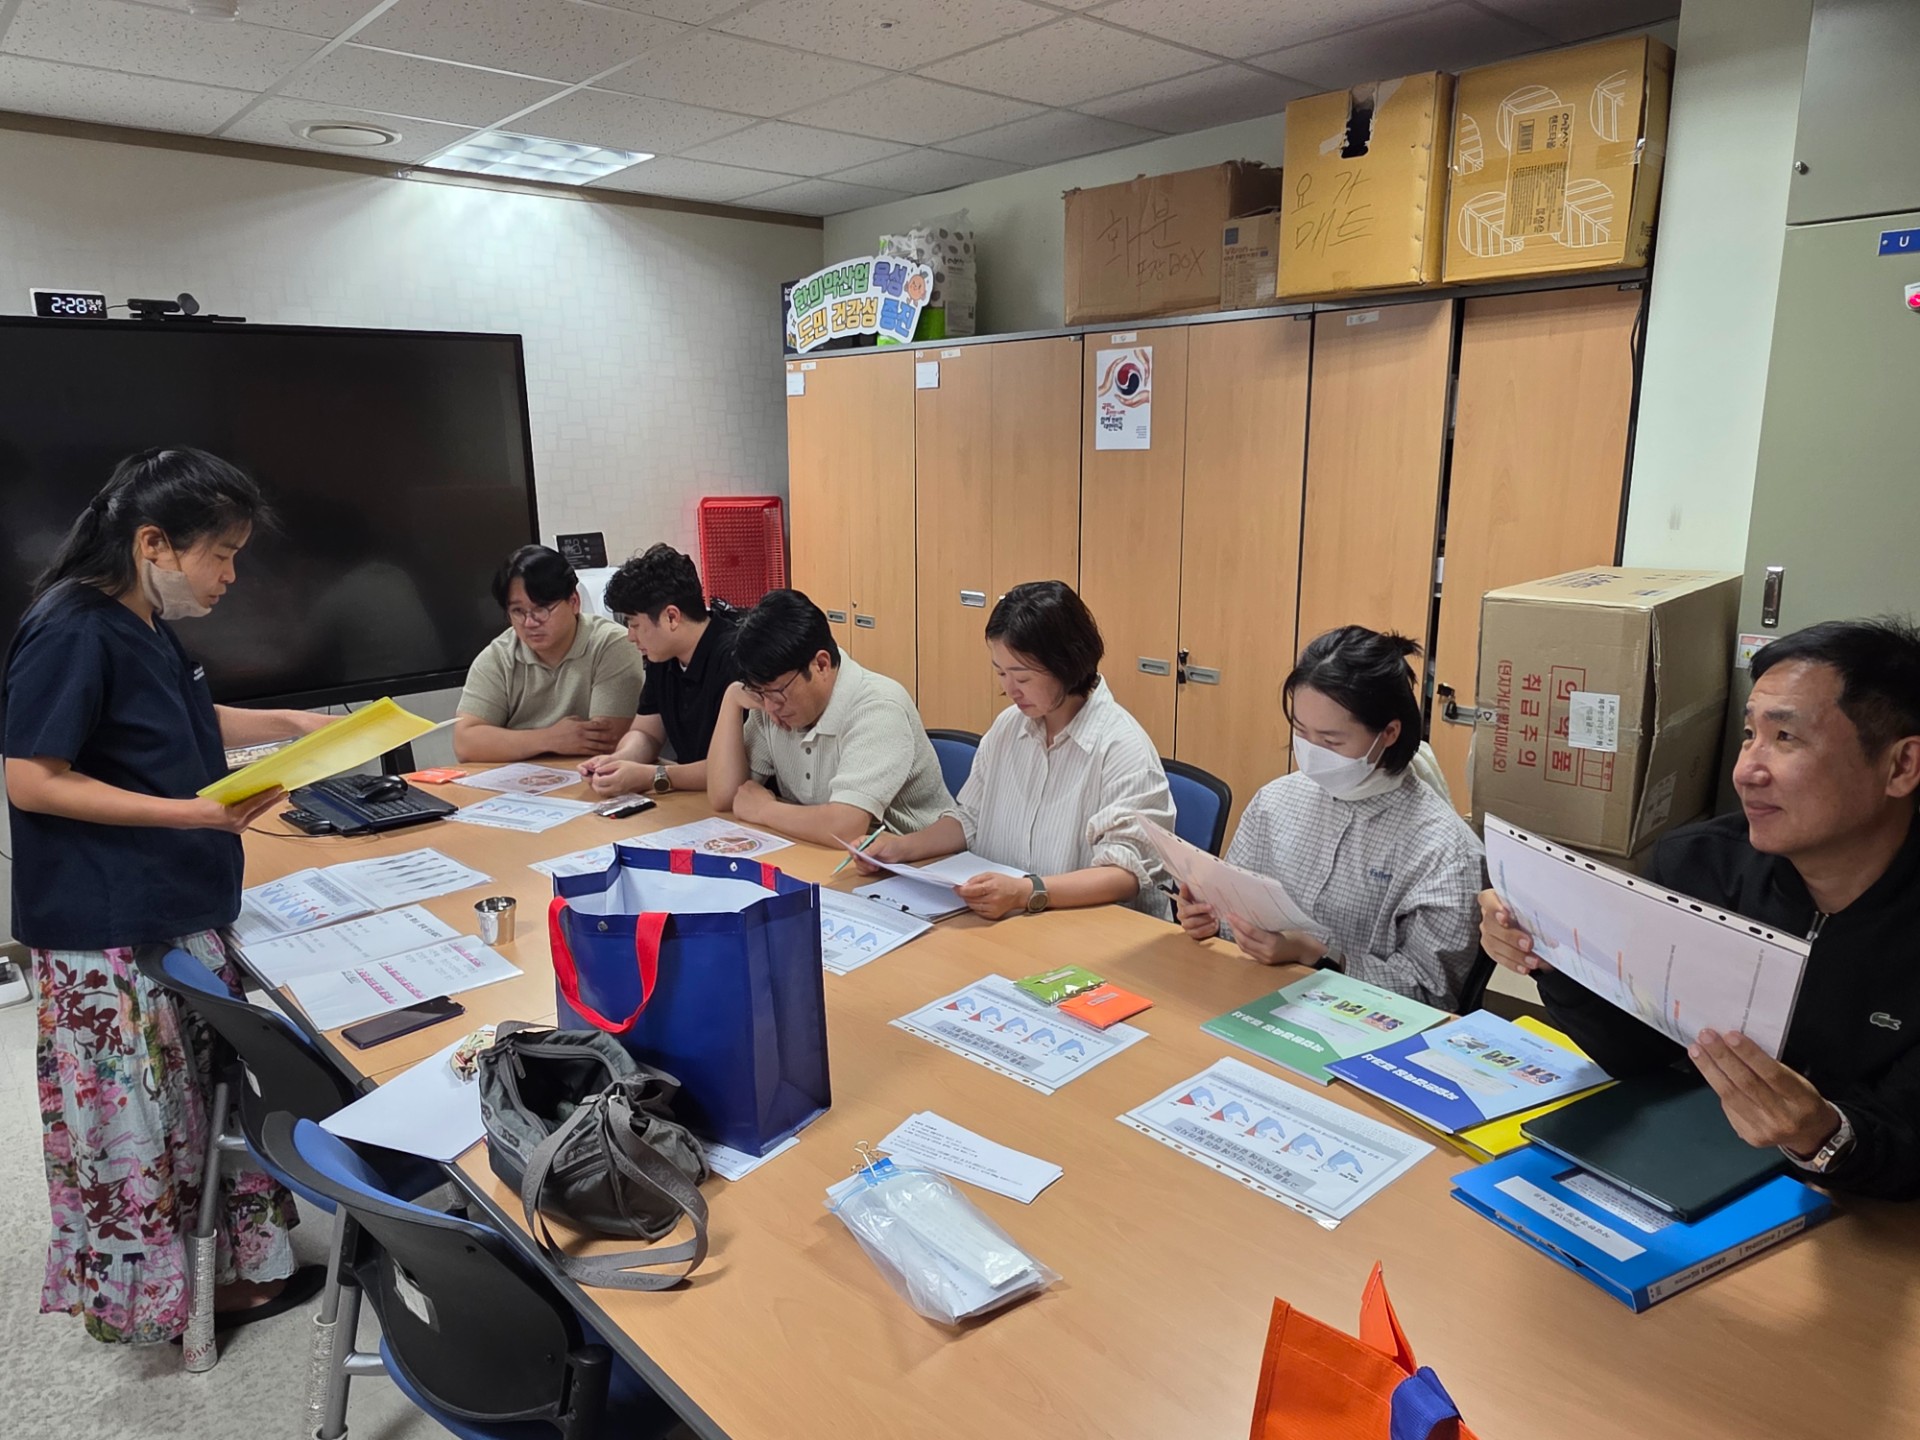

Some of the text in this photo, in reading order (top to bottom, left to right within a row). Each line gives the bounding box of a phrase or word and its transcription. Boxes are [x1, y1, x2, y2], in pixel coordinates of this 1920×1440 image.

[1295, 205, 1374, 258] 매트
[51, 296, 88, 314] 2:28
[792, 261, 871, 318] 한의약산업
[872, 261, 908, 297] 육성
[797, 296, 917, 349] 도민 건강성 증진
